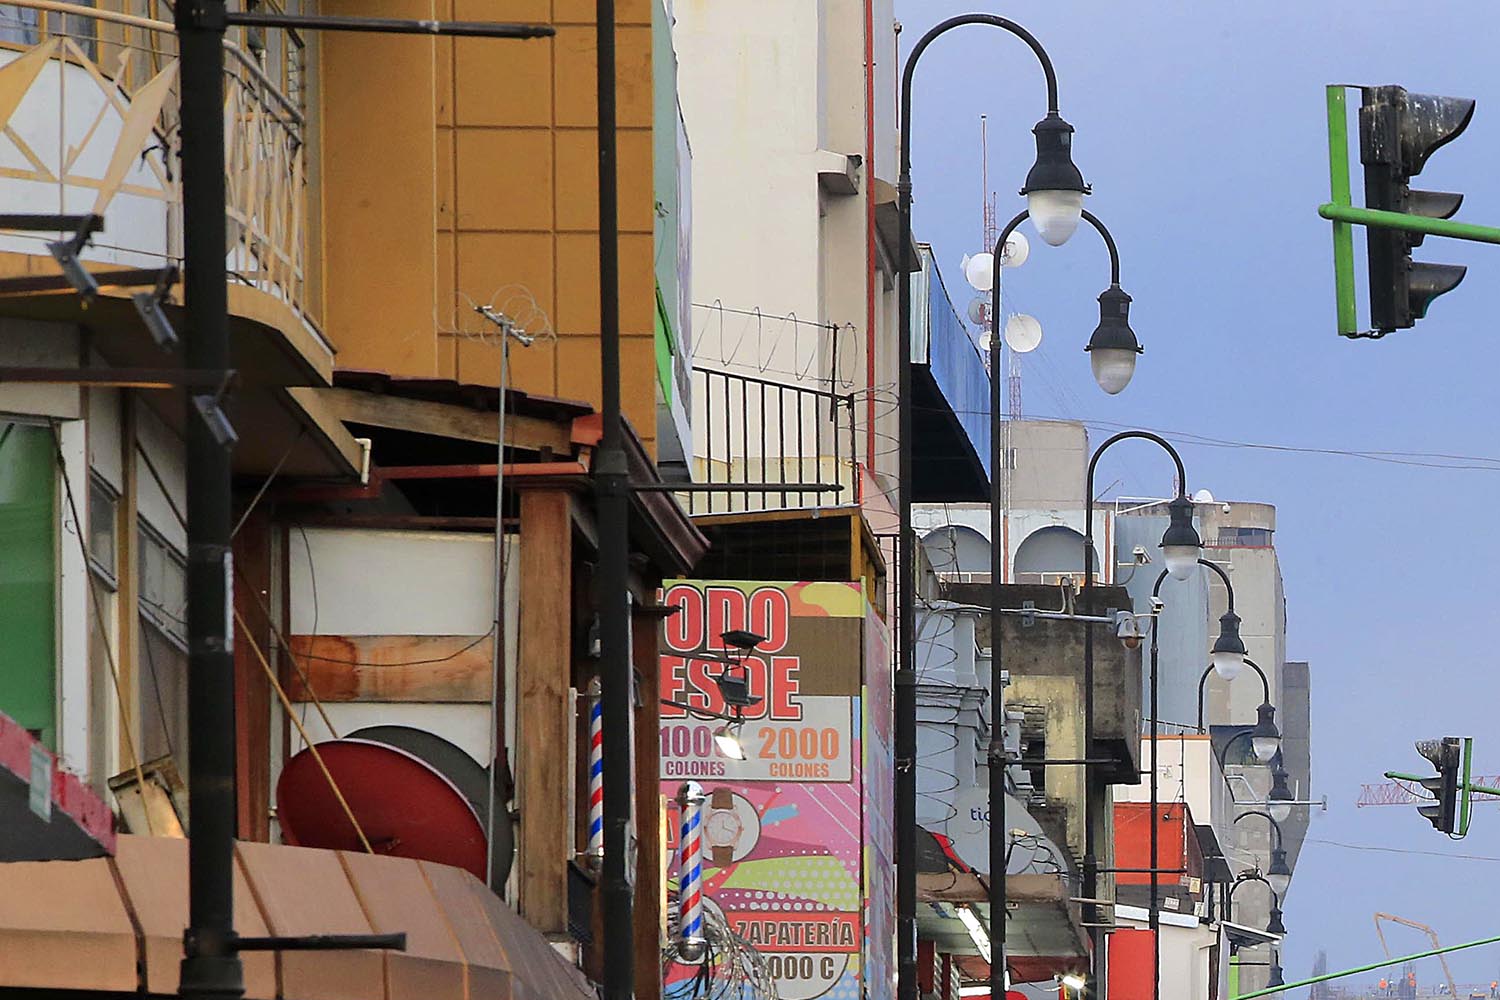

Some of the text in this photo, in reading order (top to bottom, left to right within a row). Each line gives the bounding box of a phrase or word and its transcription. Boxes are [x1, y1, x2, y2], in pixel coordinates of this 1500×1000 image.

[656, 585, 789, 652] ODO
[661, 655, 801, 718] ESDE
[758, 726, 840, 760] 2000
[665, 760, 830, 777] COLONES COLONES
[736, 918, 856, 947] ZAPATERÍA
[758, 955, 835, 981] 000 C
